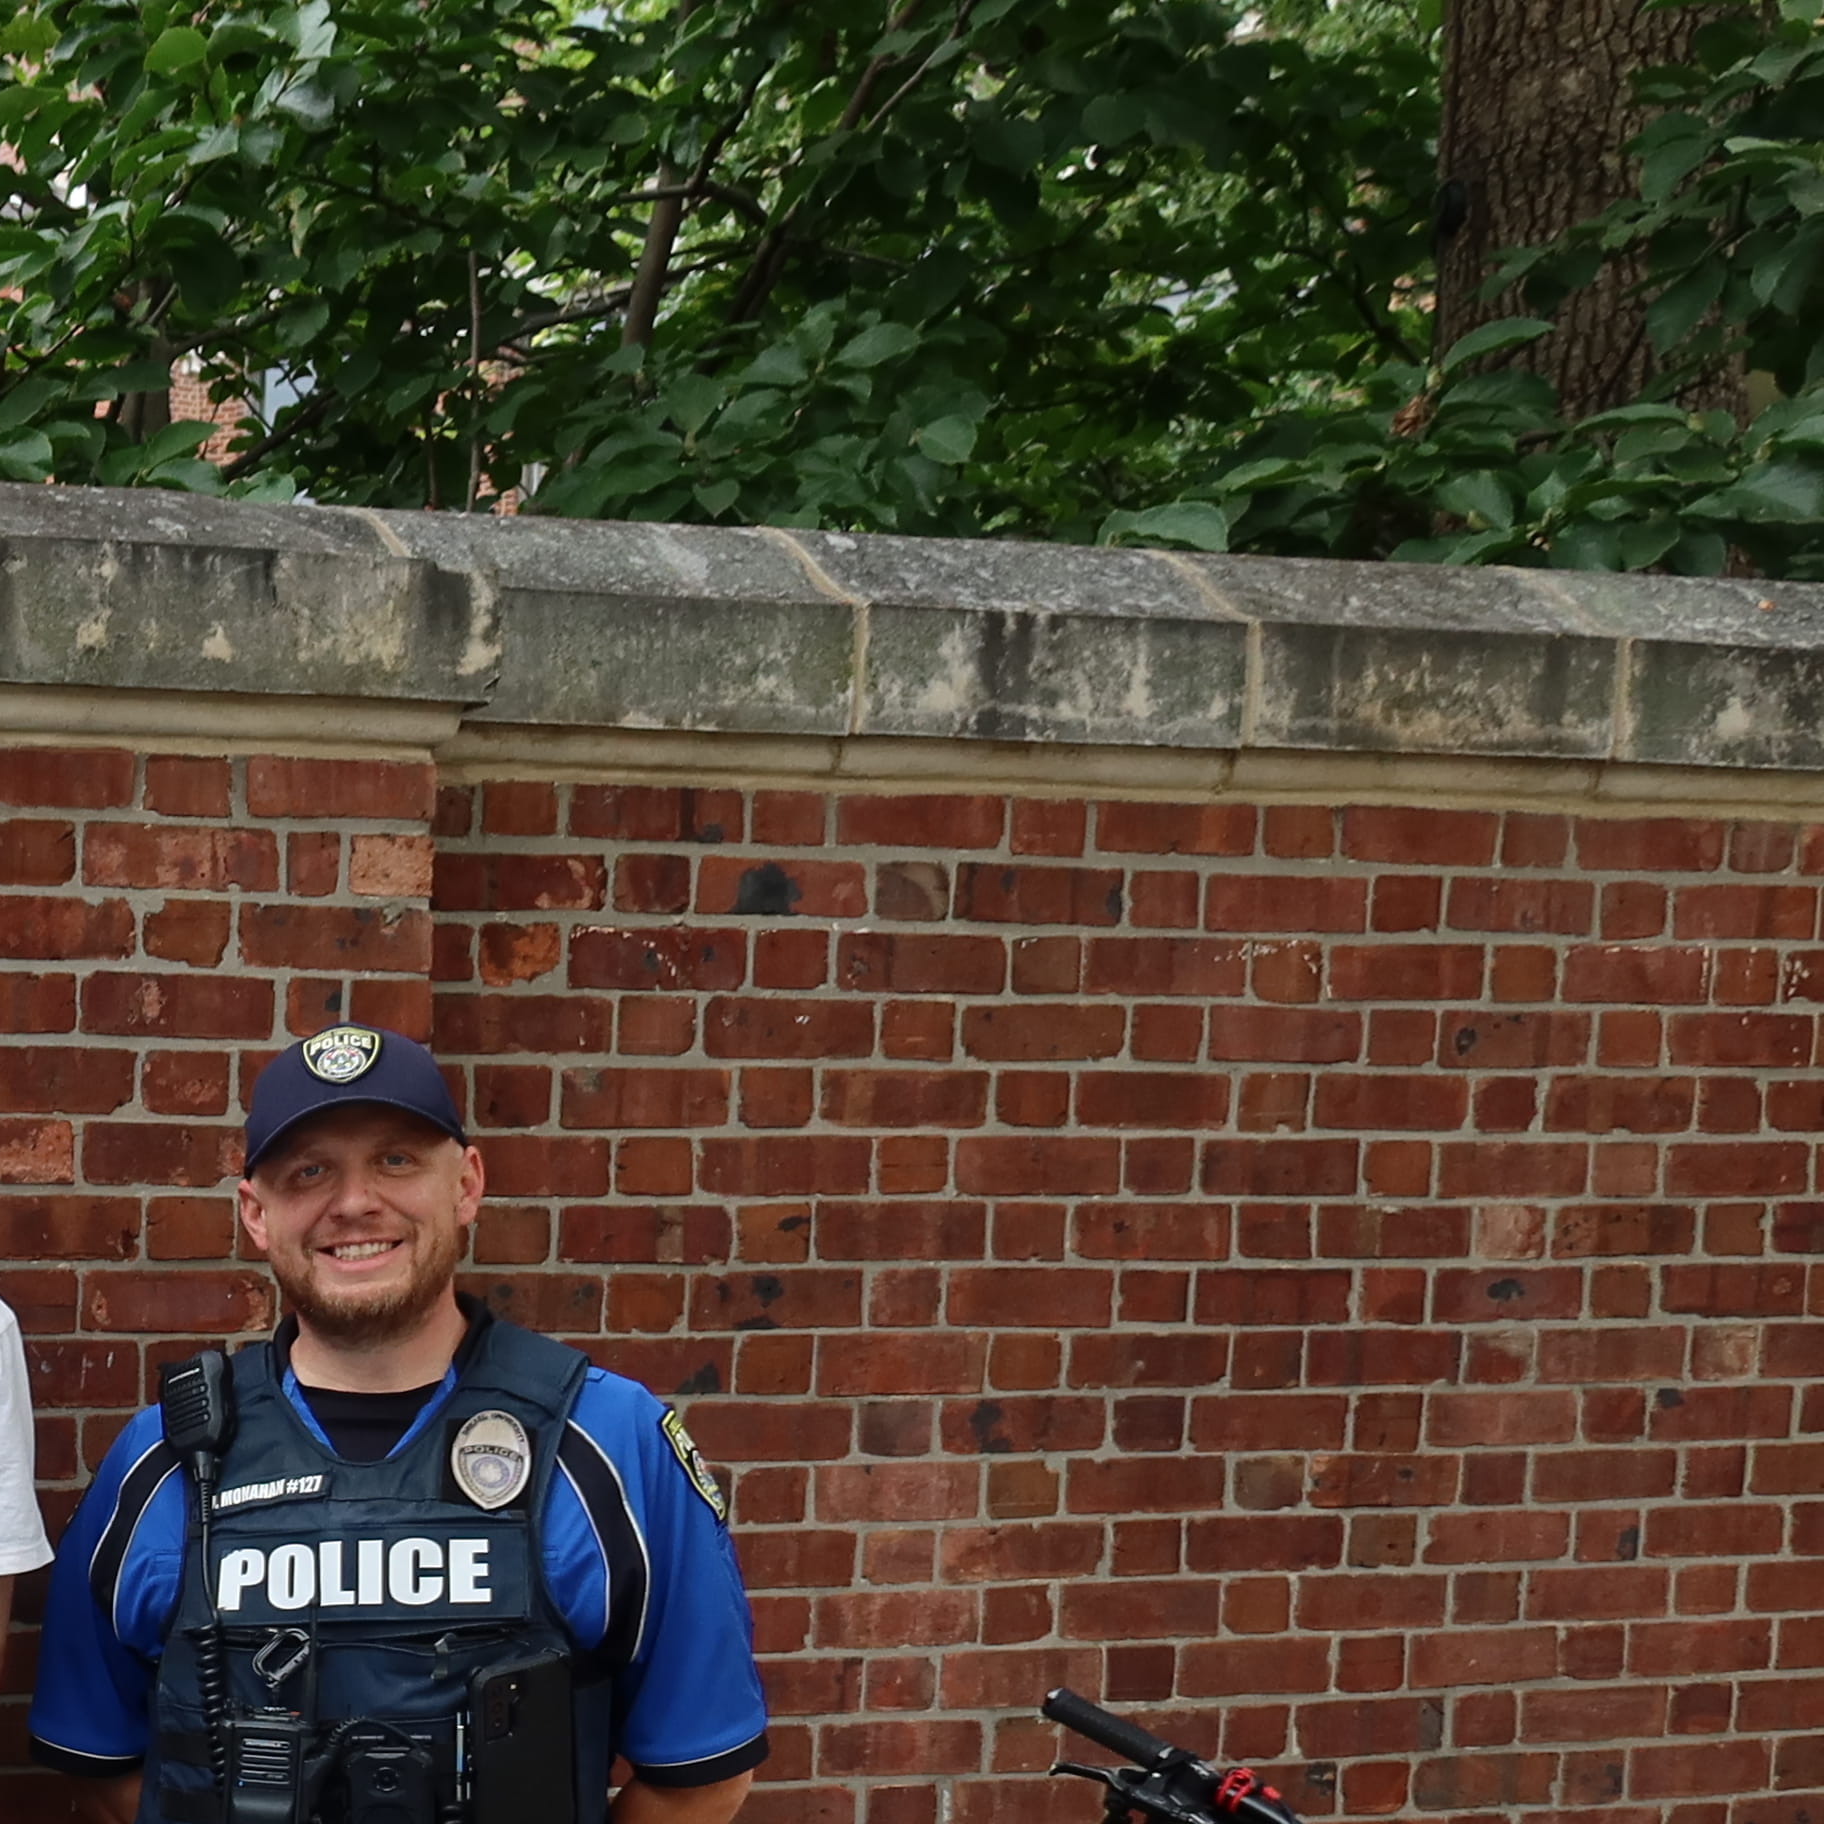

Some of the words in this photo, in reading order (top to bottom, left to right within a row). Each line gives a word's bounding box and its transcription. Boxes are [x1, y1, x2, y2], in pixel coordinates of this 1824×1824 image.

[310, 1034, 372, 1056] POLICE
[220, 1479, 286, 1507] MONAHAN
[286, 1474, 323, 1494] #127
[217, 1537, 492, 1610] POLICE
